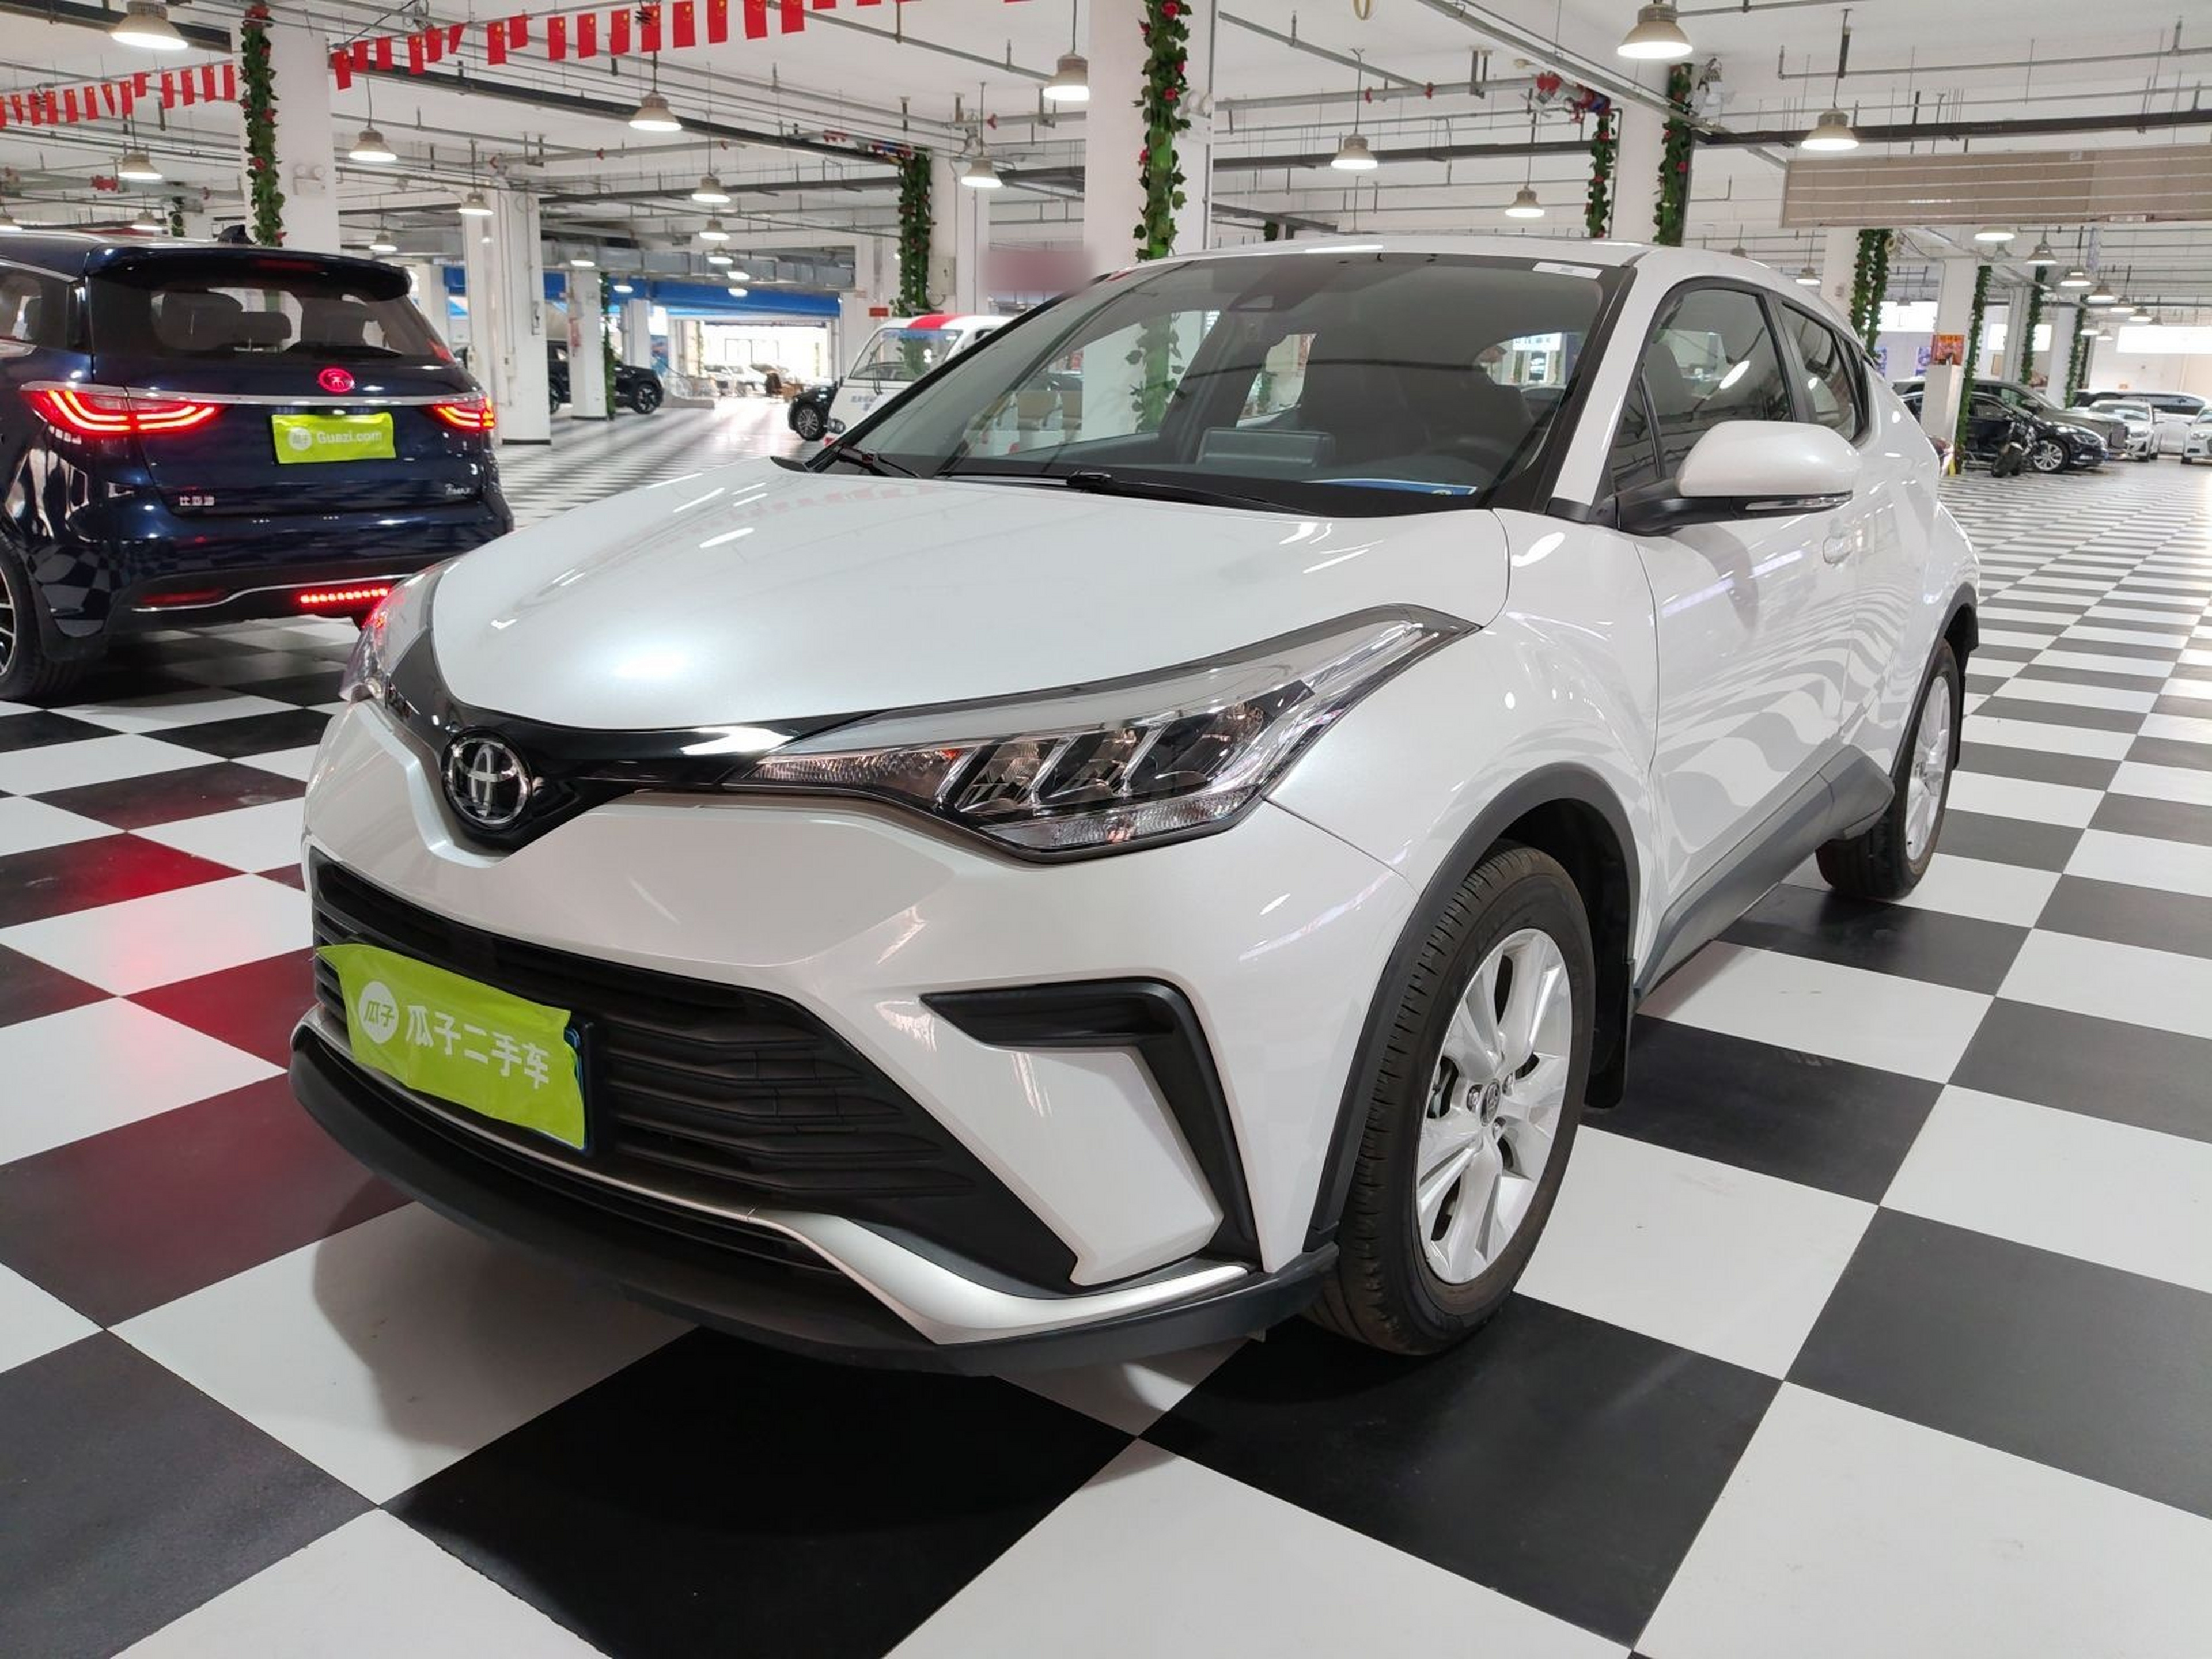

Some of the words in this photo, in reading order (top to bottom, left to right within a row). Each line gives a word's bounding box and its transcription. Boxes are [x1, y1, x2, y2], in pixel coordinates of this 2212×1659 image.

[317, 431, 382, 444] Guazi.com
[364, 1001, 395, 1027] 瓜子
[406, 1005, 550, 1089] 瓜子二手车
